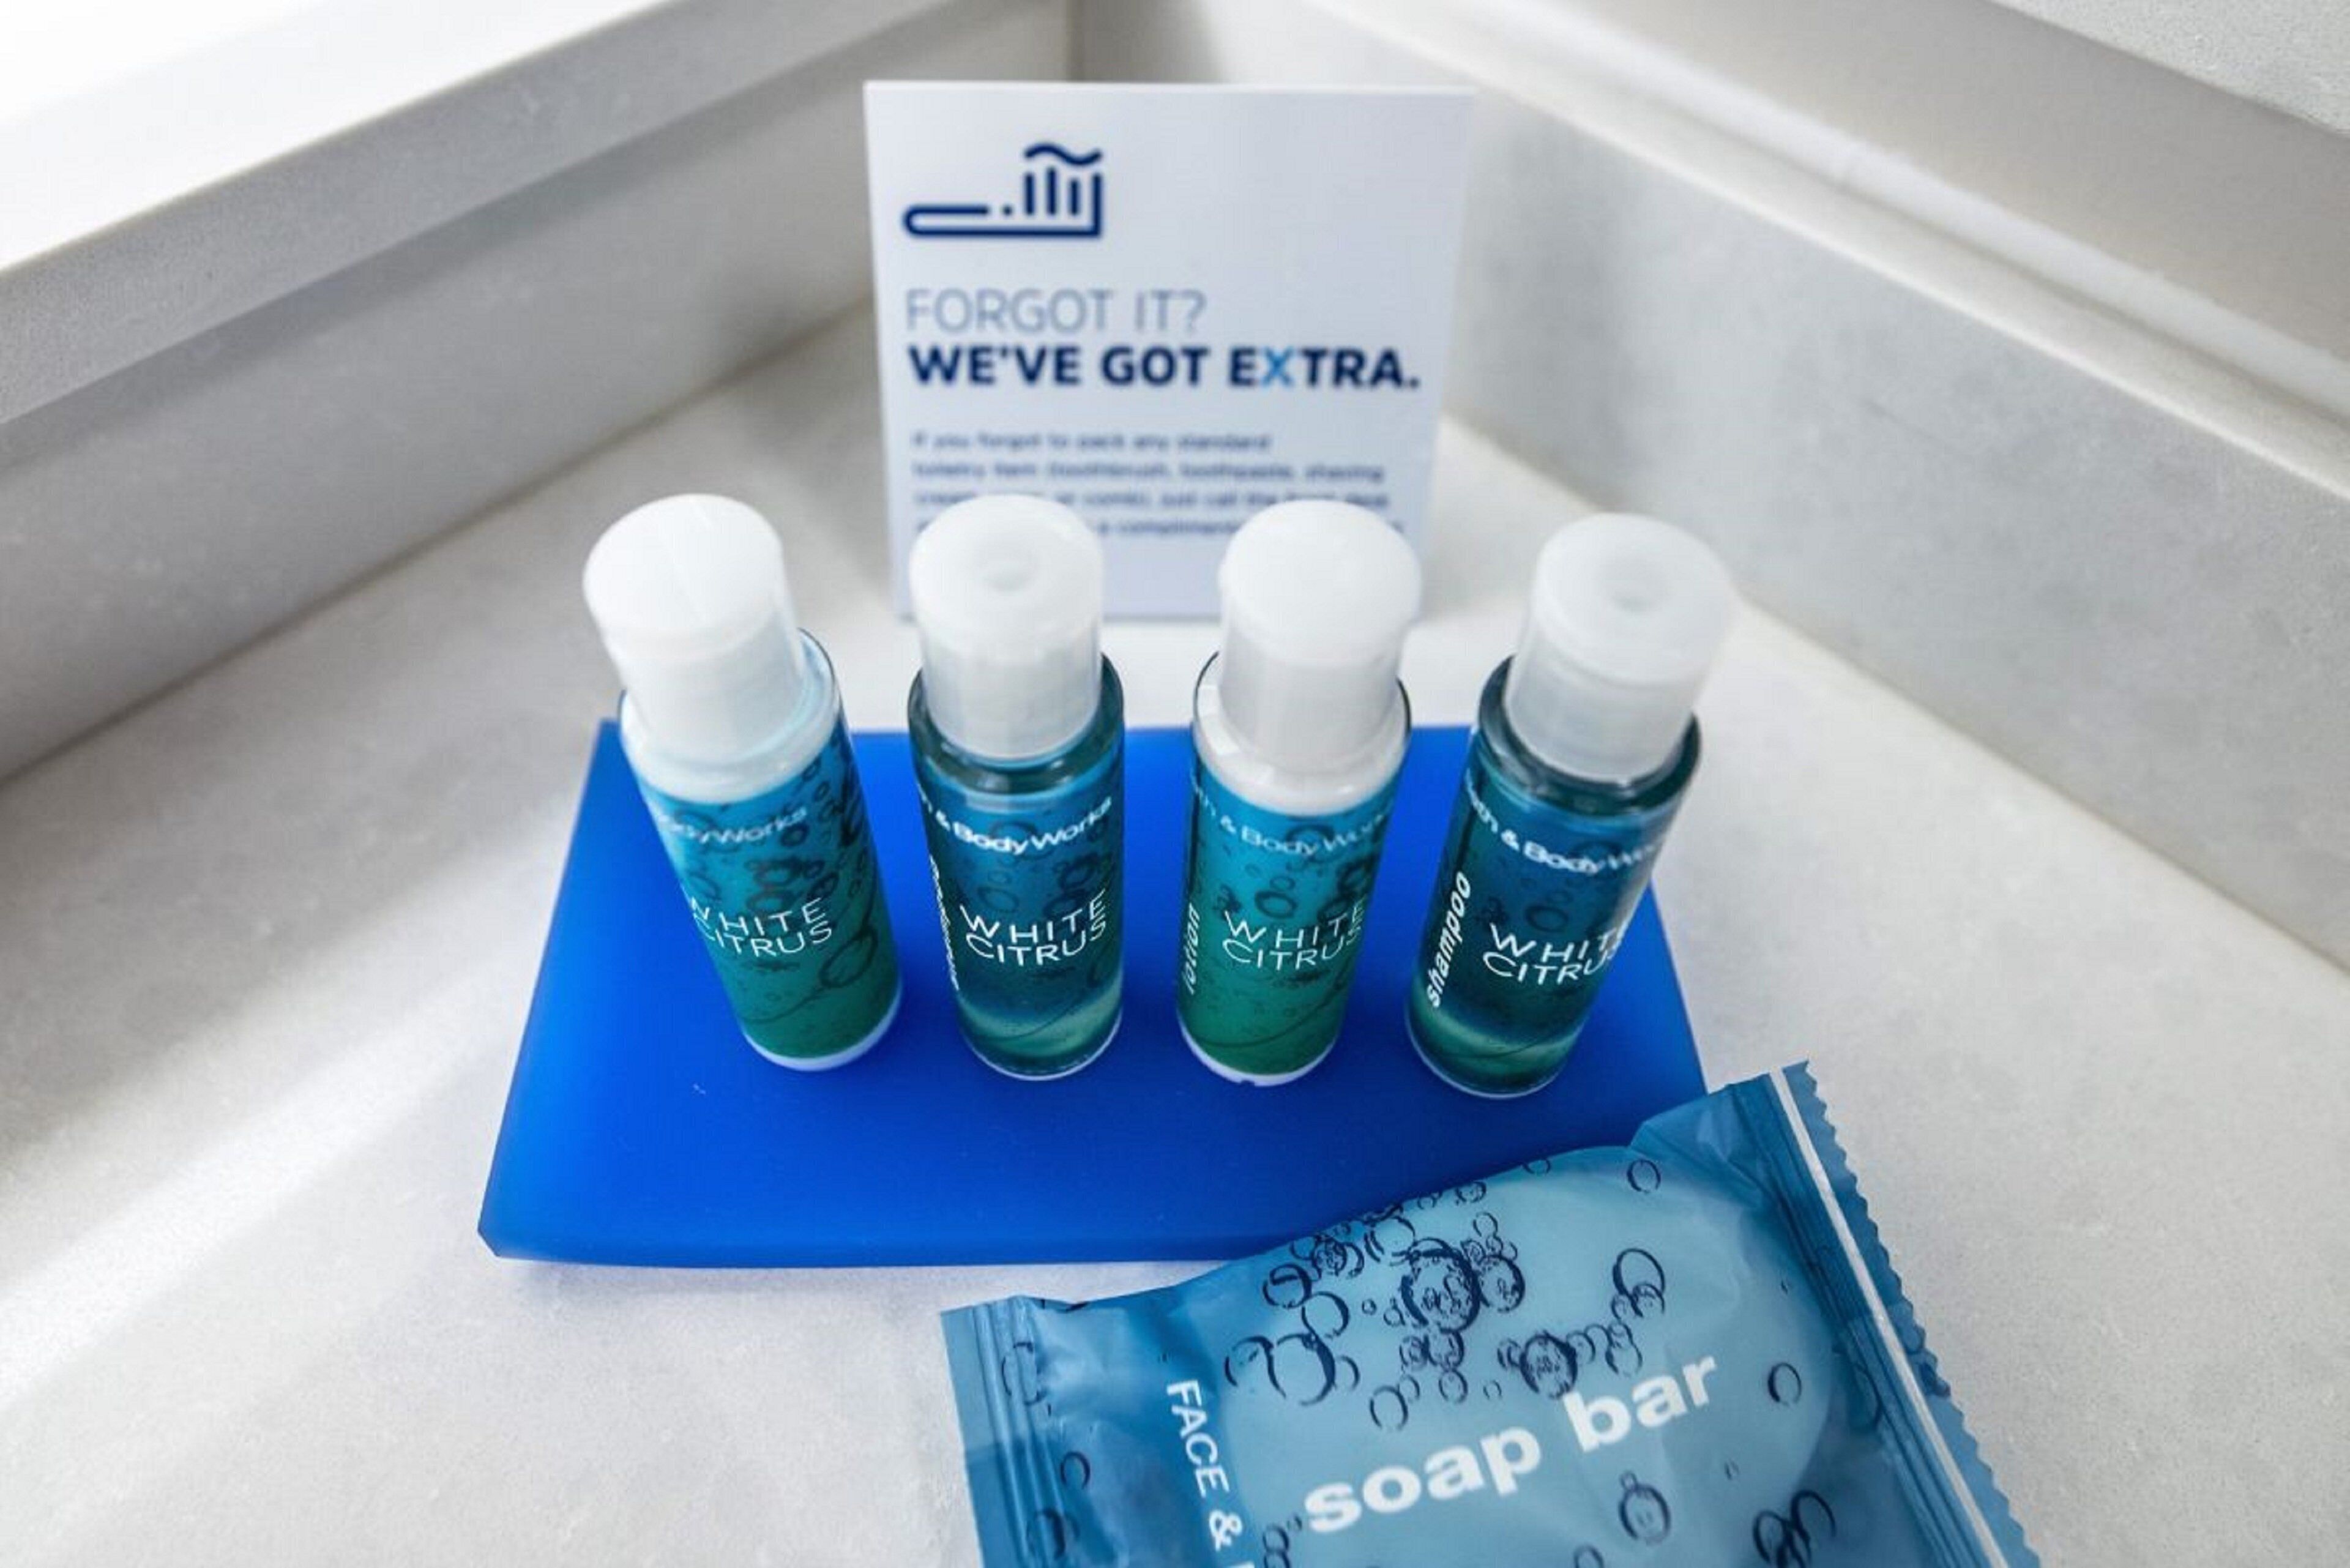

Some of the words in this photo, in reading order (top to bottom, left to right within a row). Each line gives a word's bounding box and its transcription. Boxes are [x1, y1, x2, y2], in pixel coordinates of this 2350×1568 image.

[906, 289, 1113, 334] FORGOT
[1134, 290, 1207, 335] IT?
[908, 345, 1081, 386] WE'VE
[1102, 346, 1210, 387] GOT
[1228, 347, 1420, 389] EXTRA.
[959, 887, 1106, 944] WHITE
[1224, 894, 1365, 950] WHITE
[1425, 871, 1471, 1008] shampoo
[965, 918, 1107, 966] CITRUS
[1222, 925, 1362, 971] CITRUS
[1482, 947, 1613, 985] CITRU
[1166, 1380, 1230, 1498] FACE
[1209, 1510, 1243, 1551] &
[1304, 1427, 1541, 1534] soap
[1562, 1356, 1718, 1453] bar
